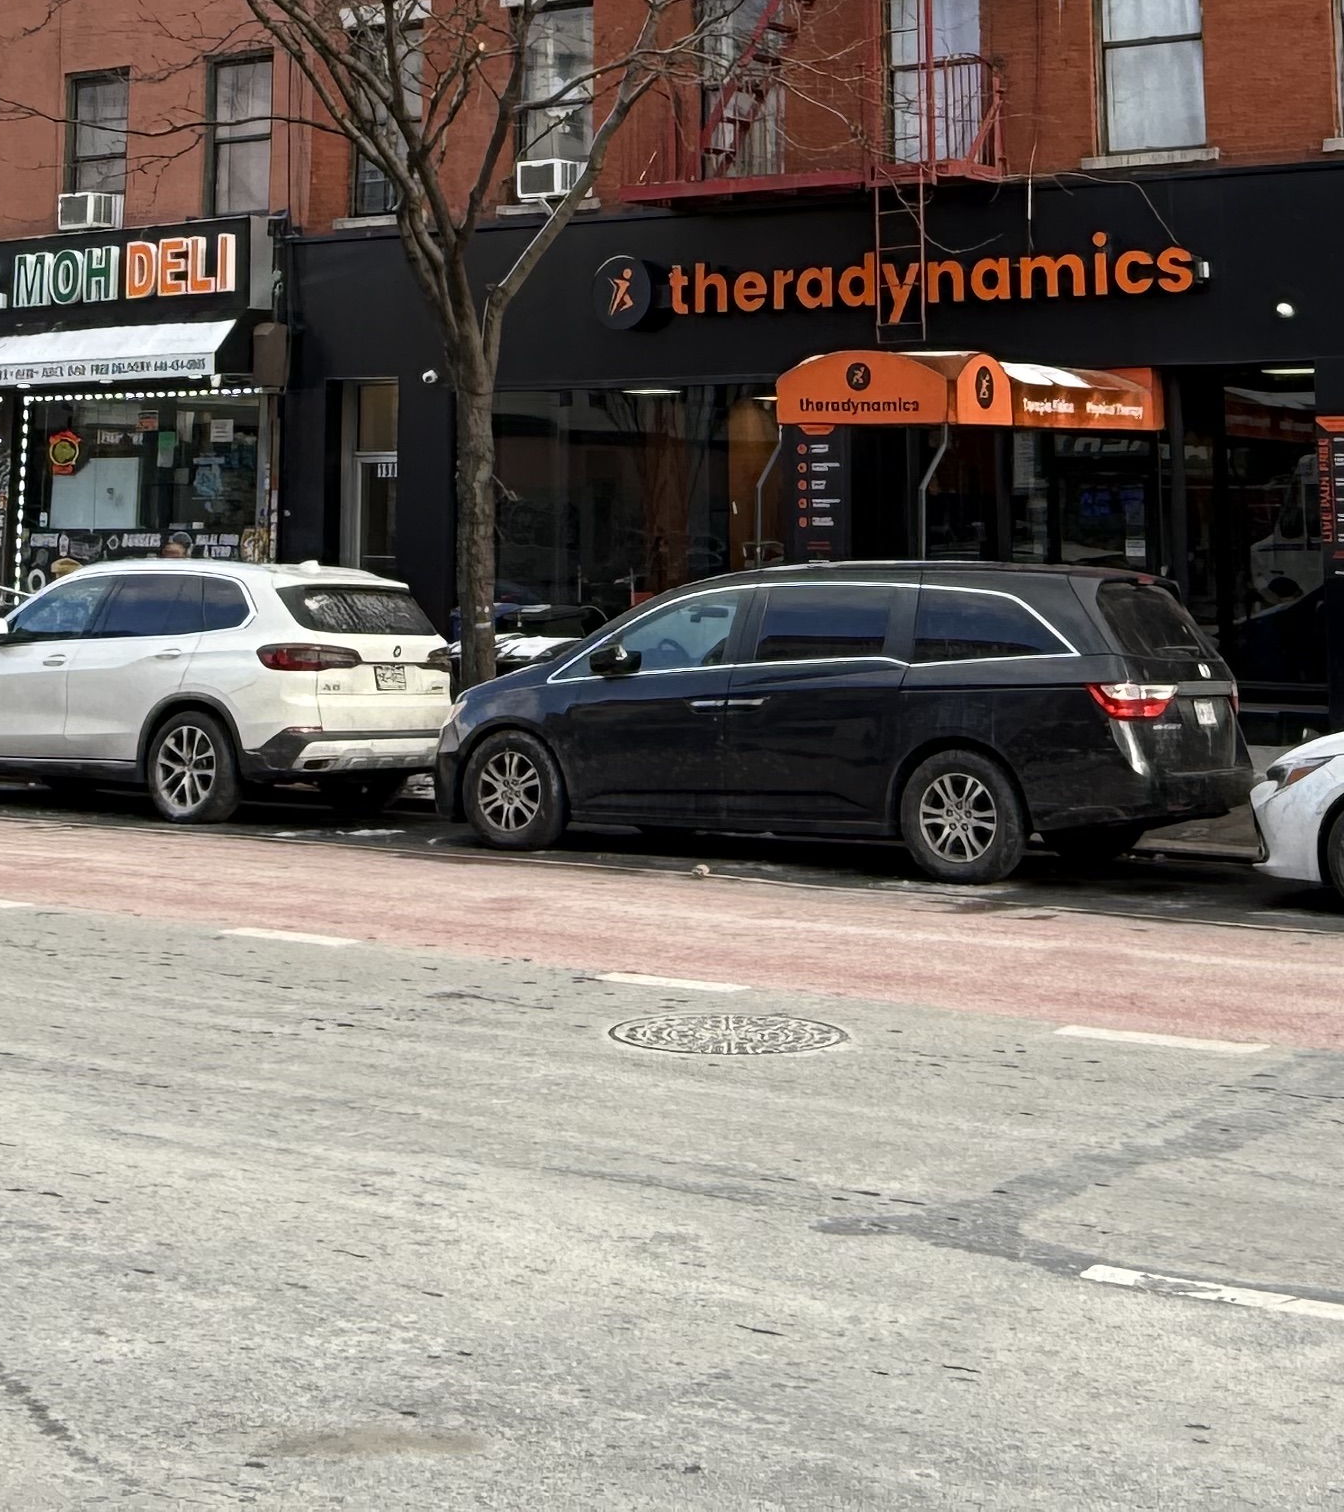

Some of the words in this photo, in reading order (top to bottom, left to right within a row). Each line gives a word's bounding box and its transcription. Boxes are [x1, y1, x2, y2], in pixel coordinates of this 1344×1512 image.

[12, 245, 120, 308] MOH
[125, 233, 236, 299] DELI
[668, 230, 1194, 325] theradynamics
[800, 397, 920, 416] theradynamics
